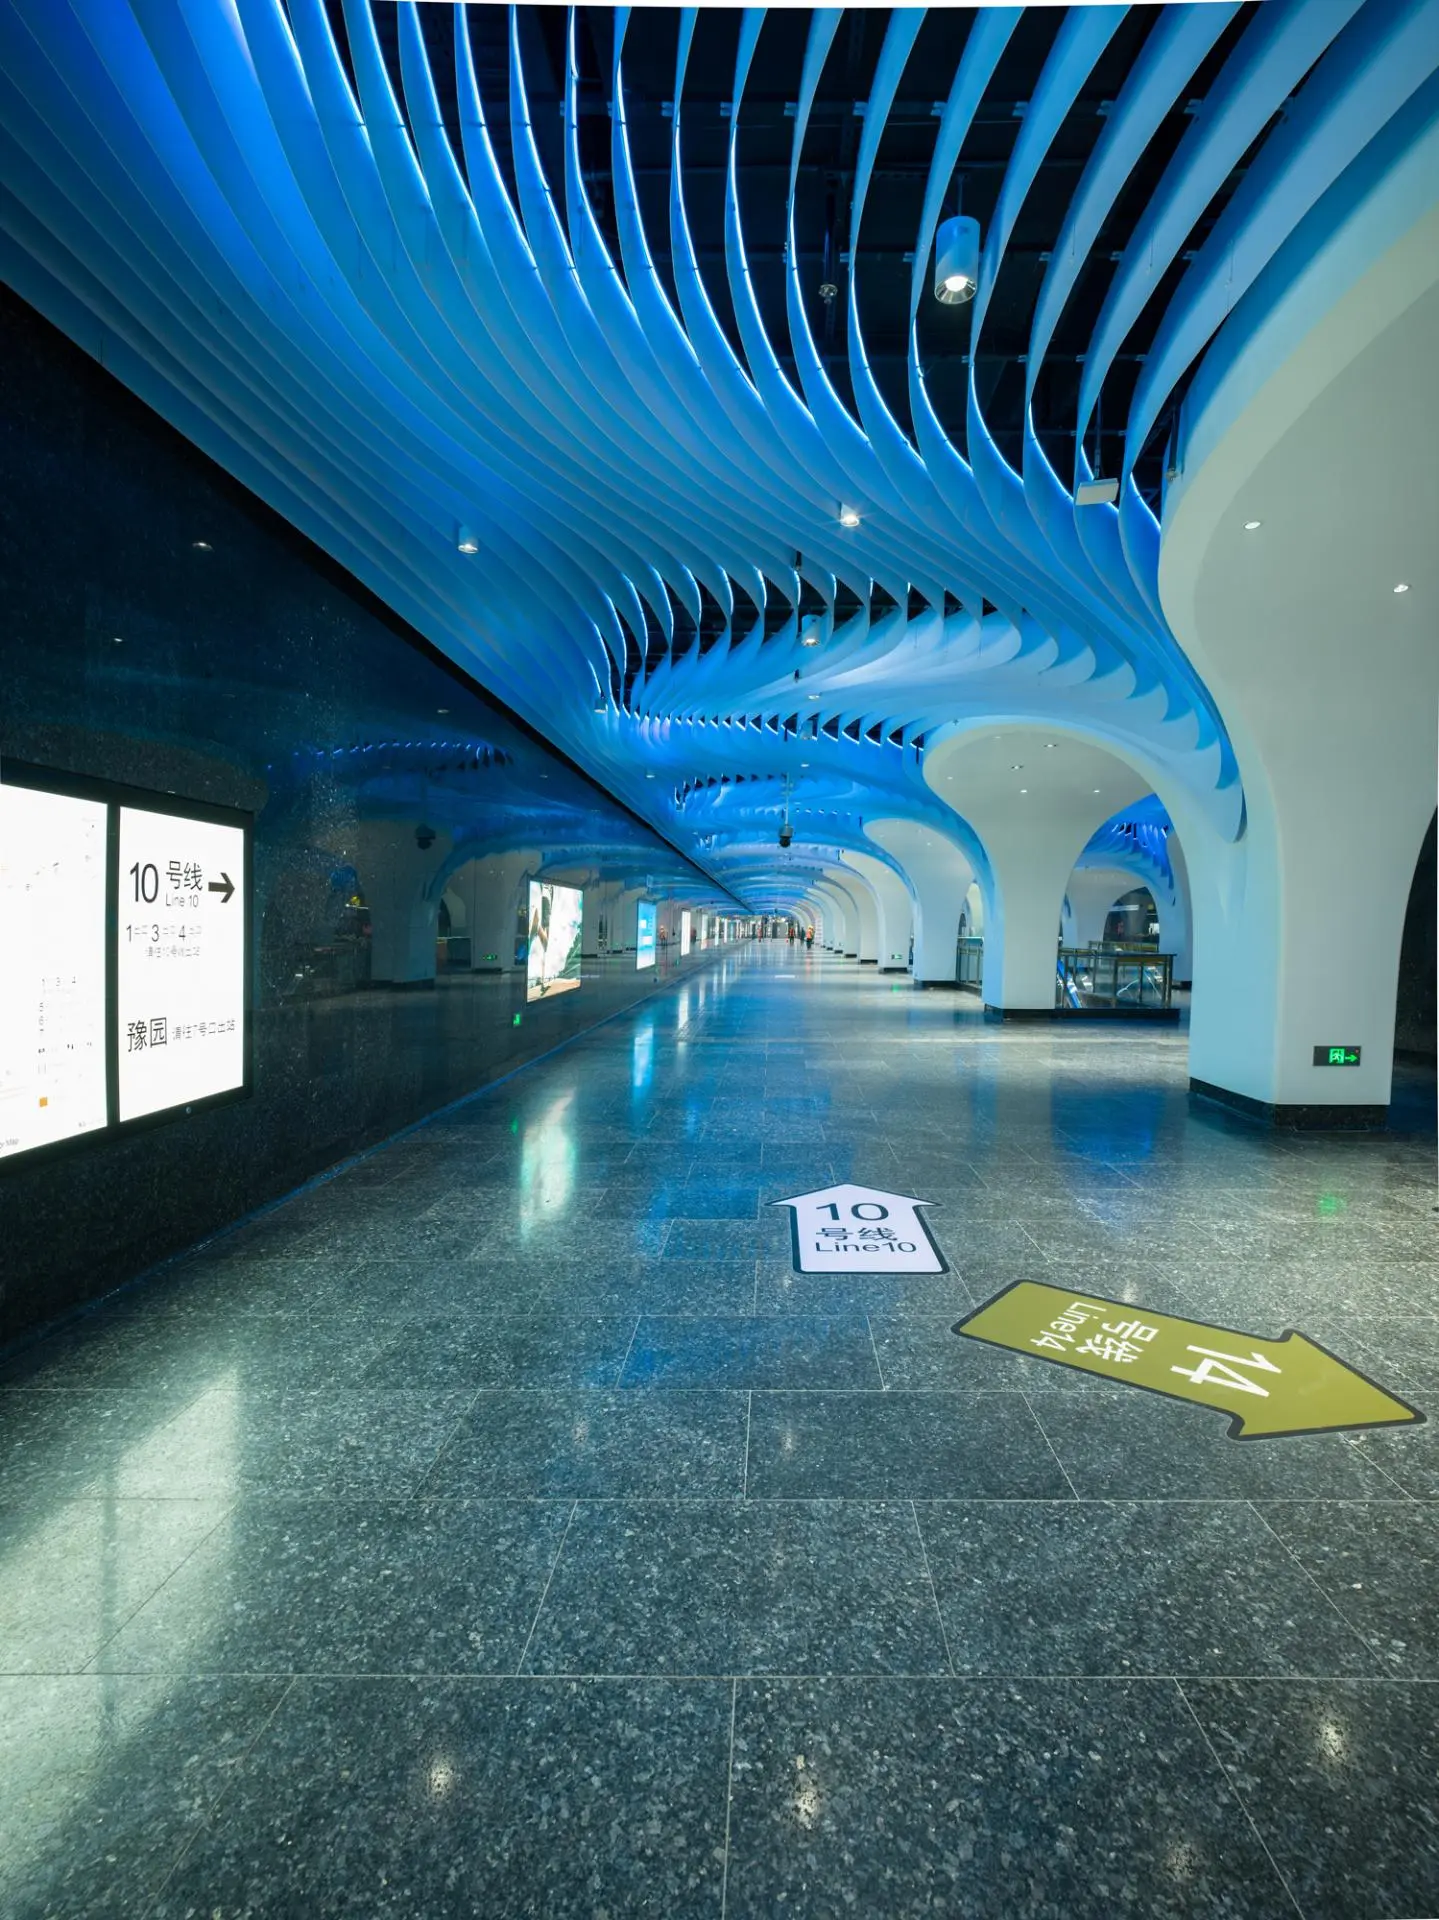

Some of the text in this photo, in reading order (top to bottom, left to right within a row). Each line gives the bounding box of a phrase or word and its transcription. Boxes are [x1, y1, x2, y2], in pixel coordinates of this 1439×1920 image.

[128, 861, 160, 904] 10
[165, 860, 203, 891] 号线
[189, 894, 200, 908] 10
[126, 1016, 168, 1053] 豫园
[815, 1202, 889, 1221] 10
[815, 1227, 898, 1241] 号线
[815, 1241, 917, 1253] Line10
[1075, 1320, 1160, 1363] 号线
[1170, 1344, 1282, 1397] 14
